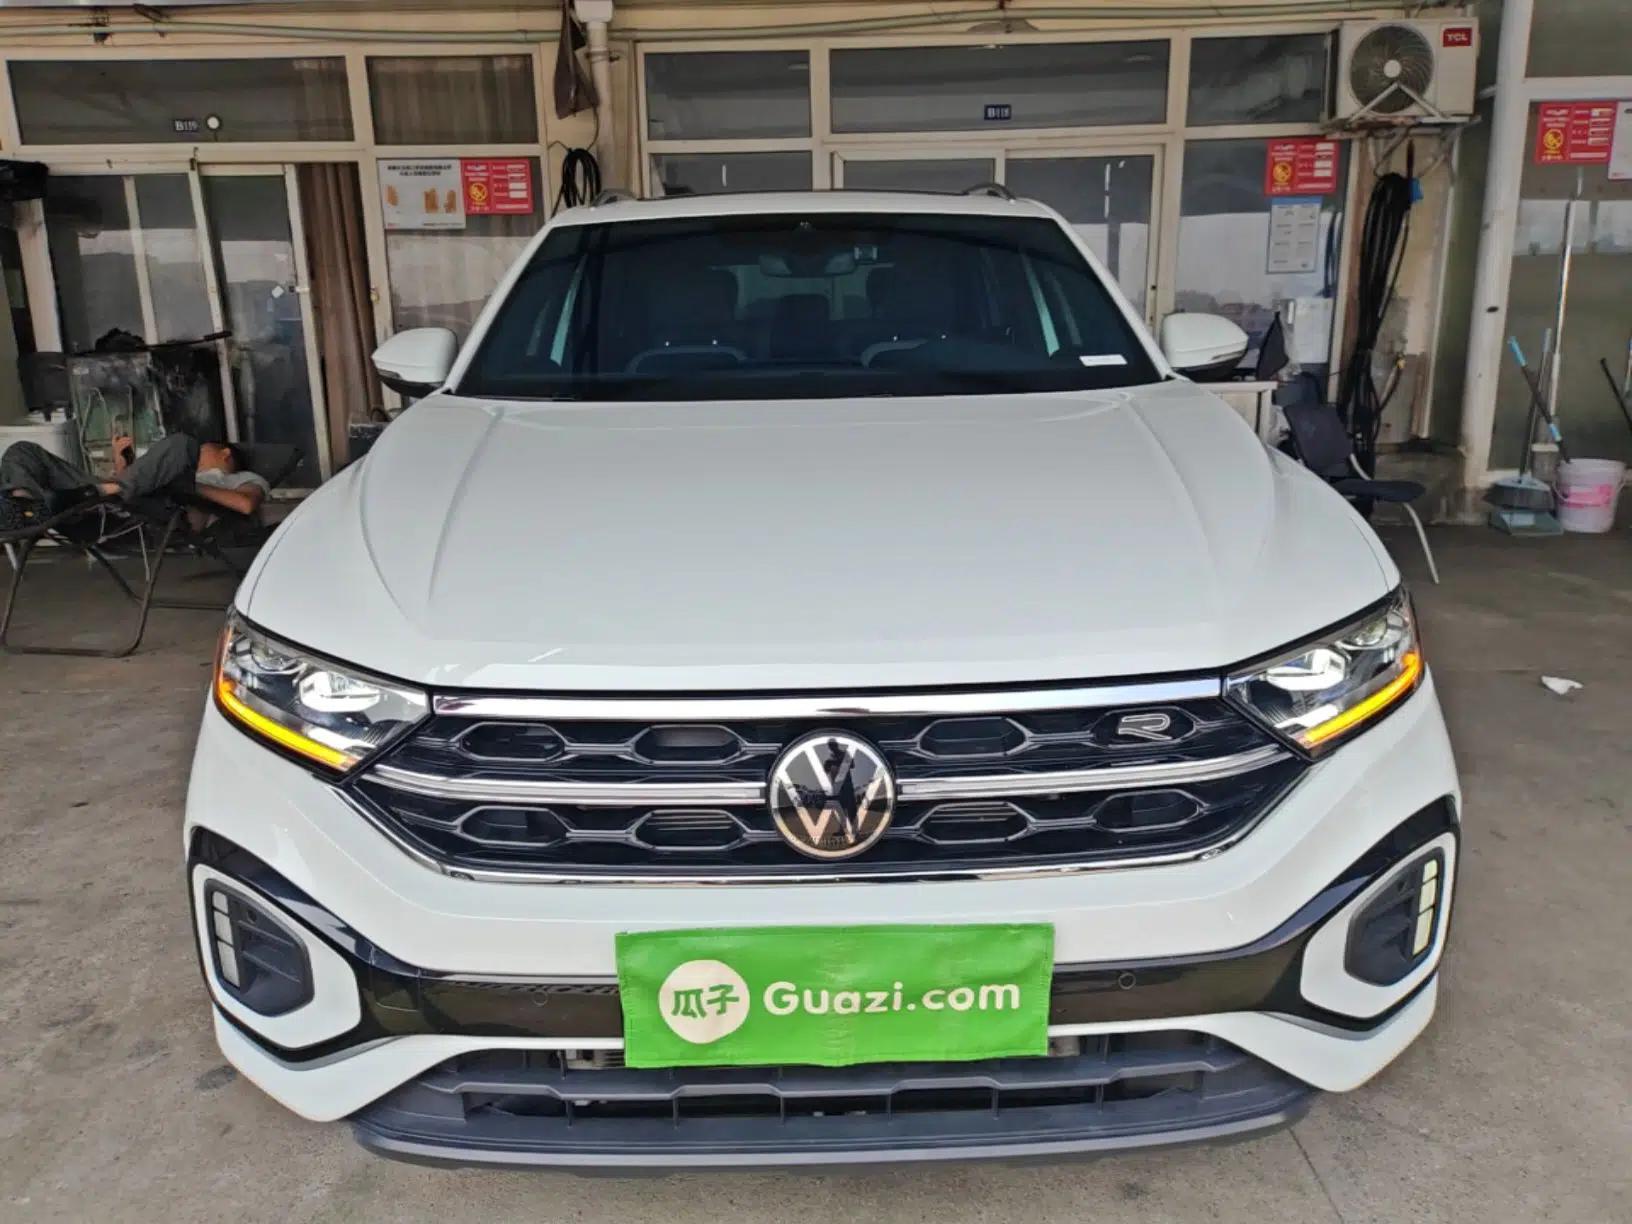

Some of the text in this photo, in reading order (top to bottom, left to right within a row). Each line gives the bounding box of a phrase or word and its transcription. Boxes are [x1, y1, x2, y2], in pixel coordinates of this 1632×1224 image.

[1118, 713, 1172, 740] R
[671, 984, 740, 1019] 瓜子
[763, 981, 1020, 1016] Guazi.com
